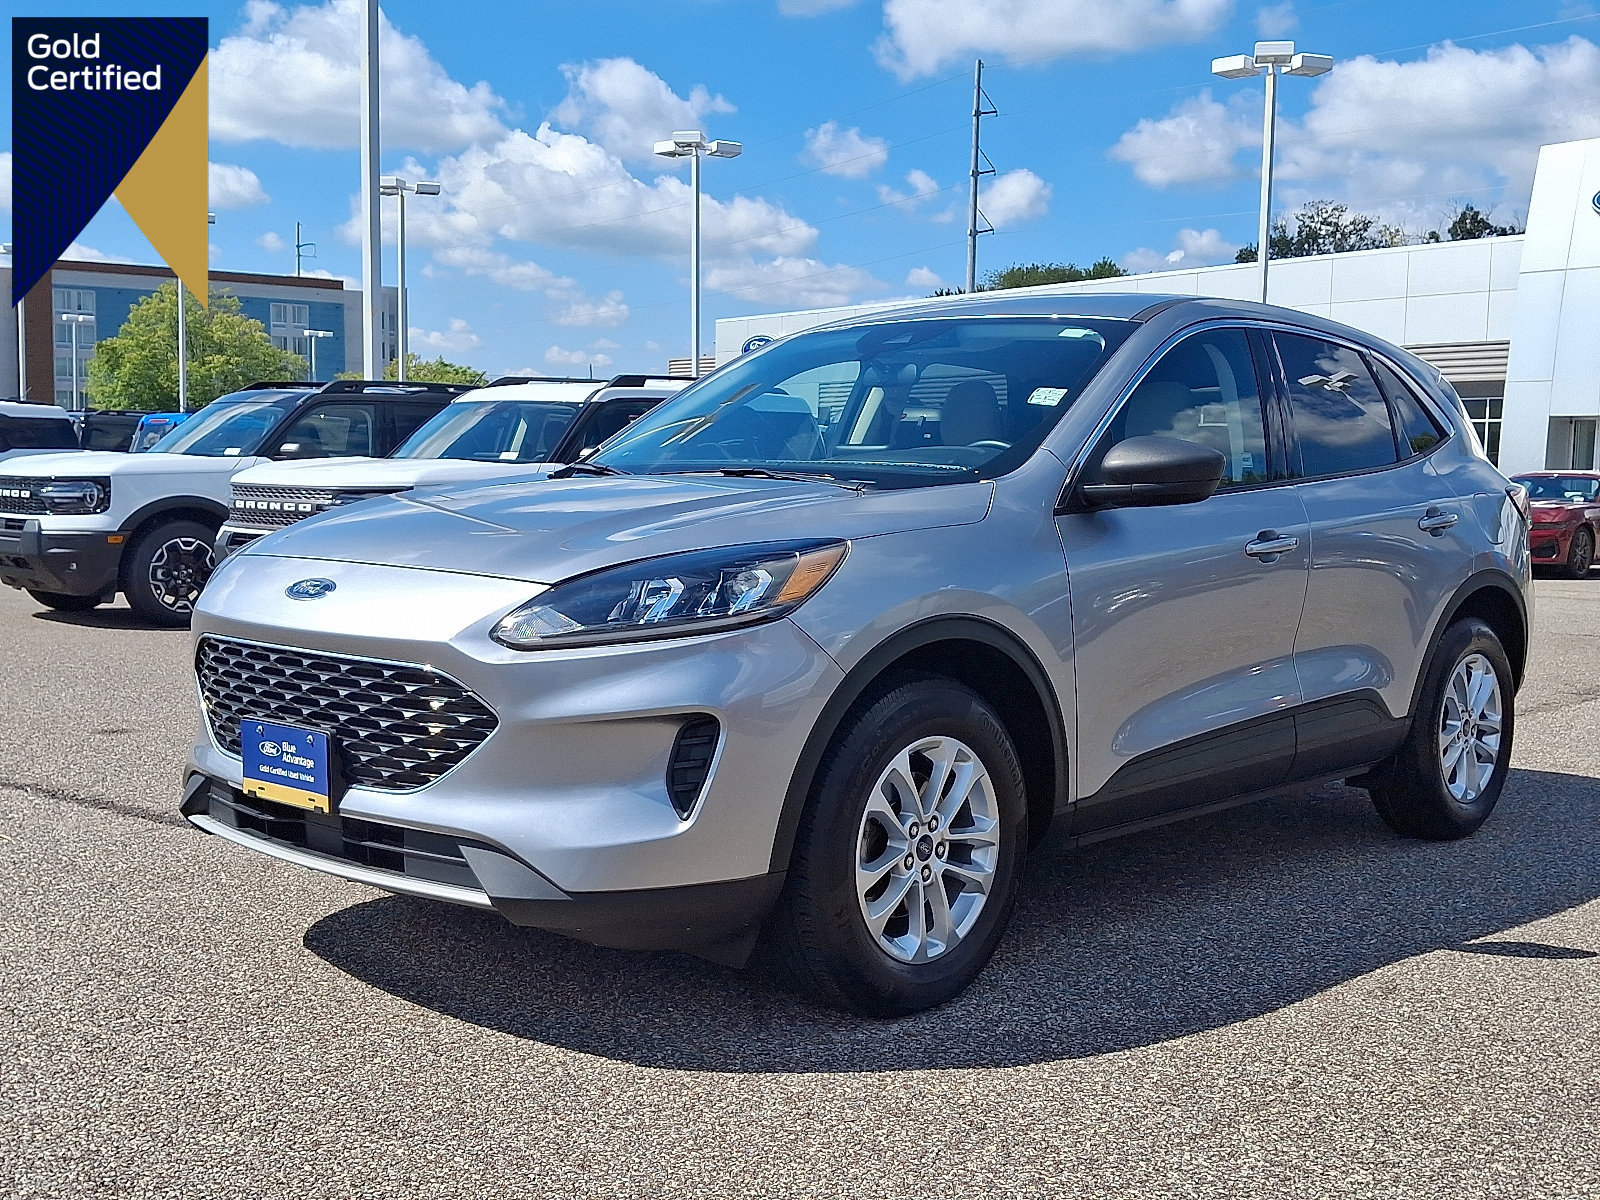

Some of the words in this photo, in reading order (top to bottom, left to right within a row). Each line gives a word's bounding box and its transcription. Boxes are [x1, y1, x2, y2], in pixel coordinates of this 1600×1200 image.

[0, 489, 30, 498] NCO
[235, 500, 312, 512] BRONCO
[262, 742, 279, 755] Ford
[282, 741, 297, 754] Blue
[282, 752, 315, 769] Advantage
[259, 765, 270, 773] Gold
[270, 767, 288, 777] Certified
[288, 771, 299, 780] Used
